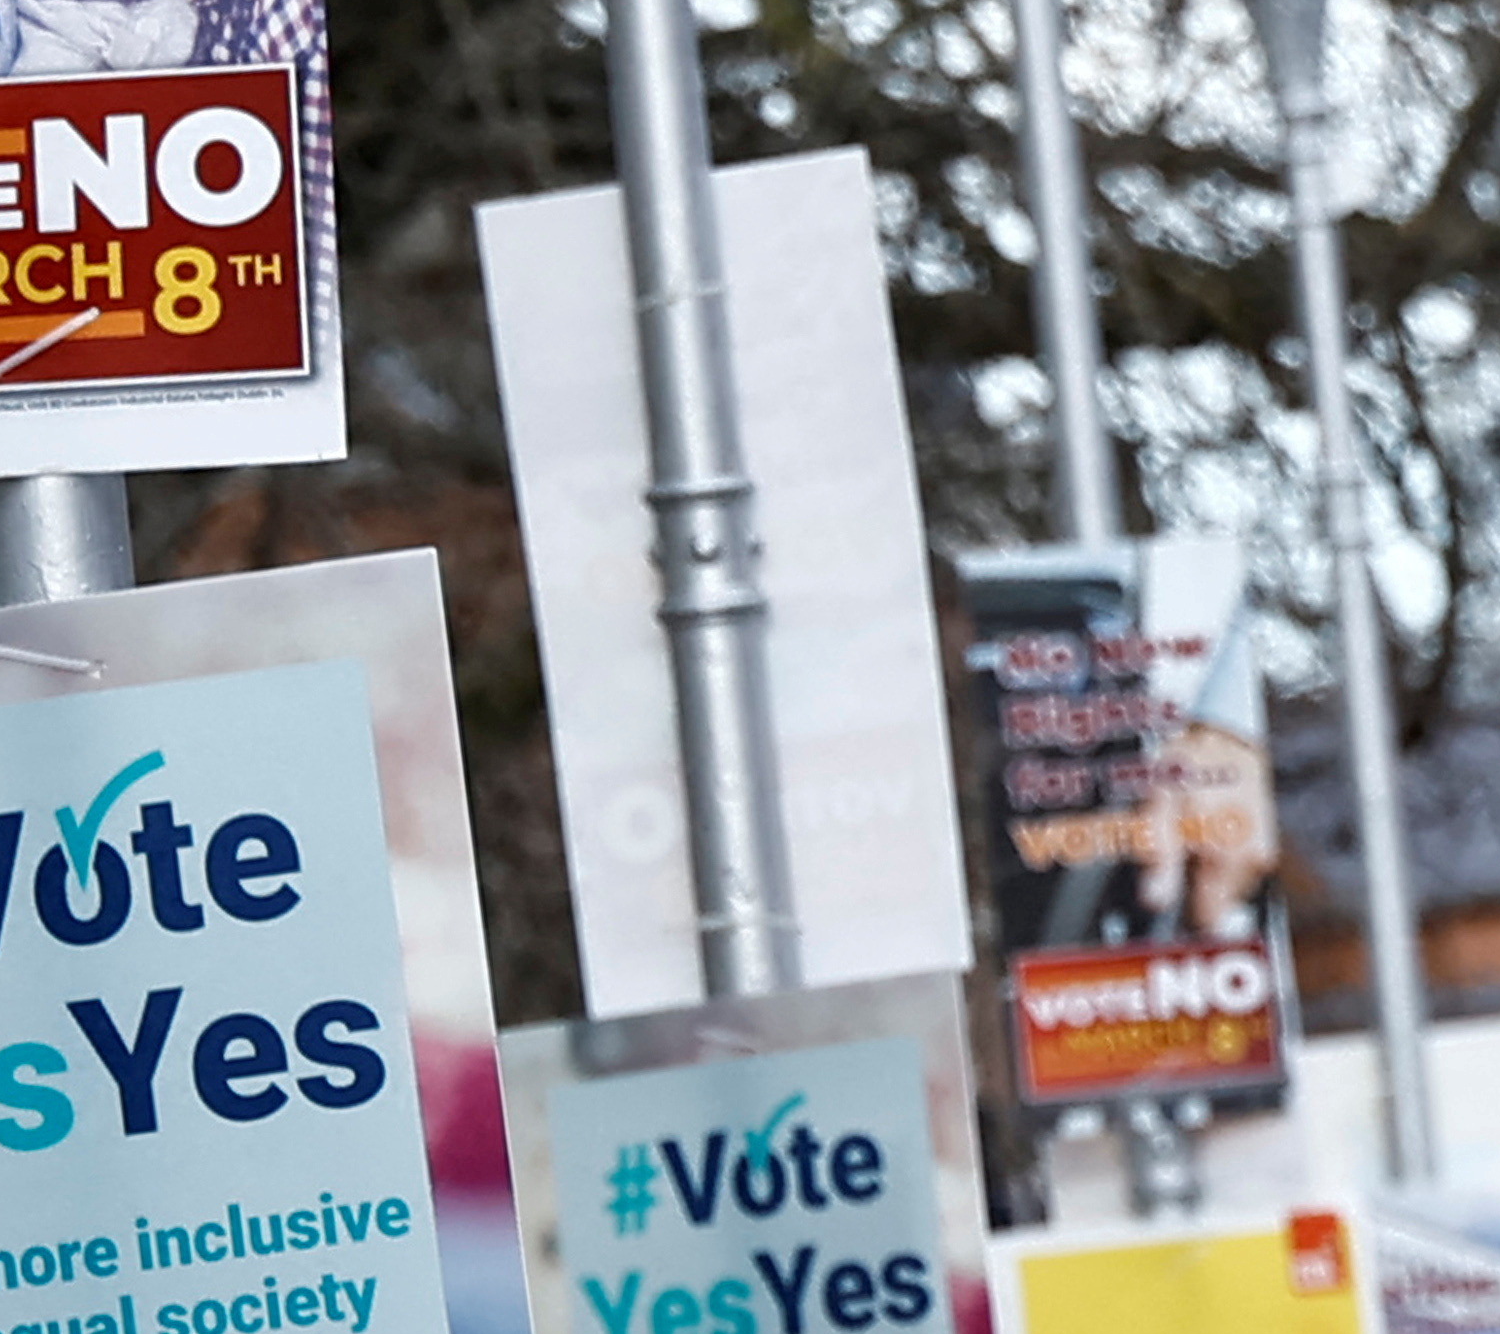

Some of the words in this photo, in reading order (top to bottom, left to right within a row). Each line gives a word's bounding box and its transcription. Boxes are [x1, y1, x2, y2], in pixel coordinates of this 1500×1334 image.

[32, 107, 283, 234] NO
[1011, 817, 1149, 872] VOTE
[1147, 952, 1267, 1018] NO
[606, 1122, 884, 1237] #Vote
[136, 1192, 411, 1270] inclusive
